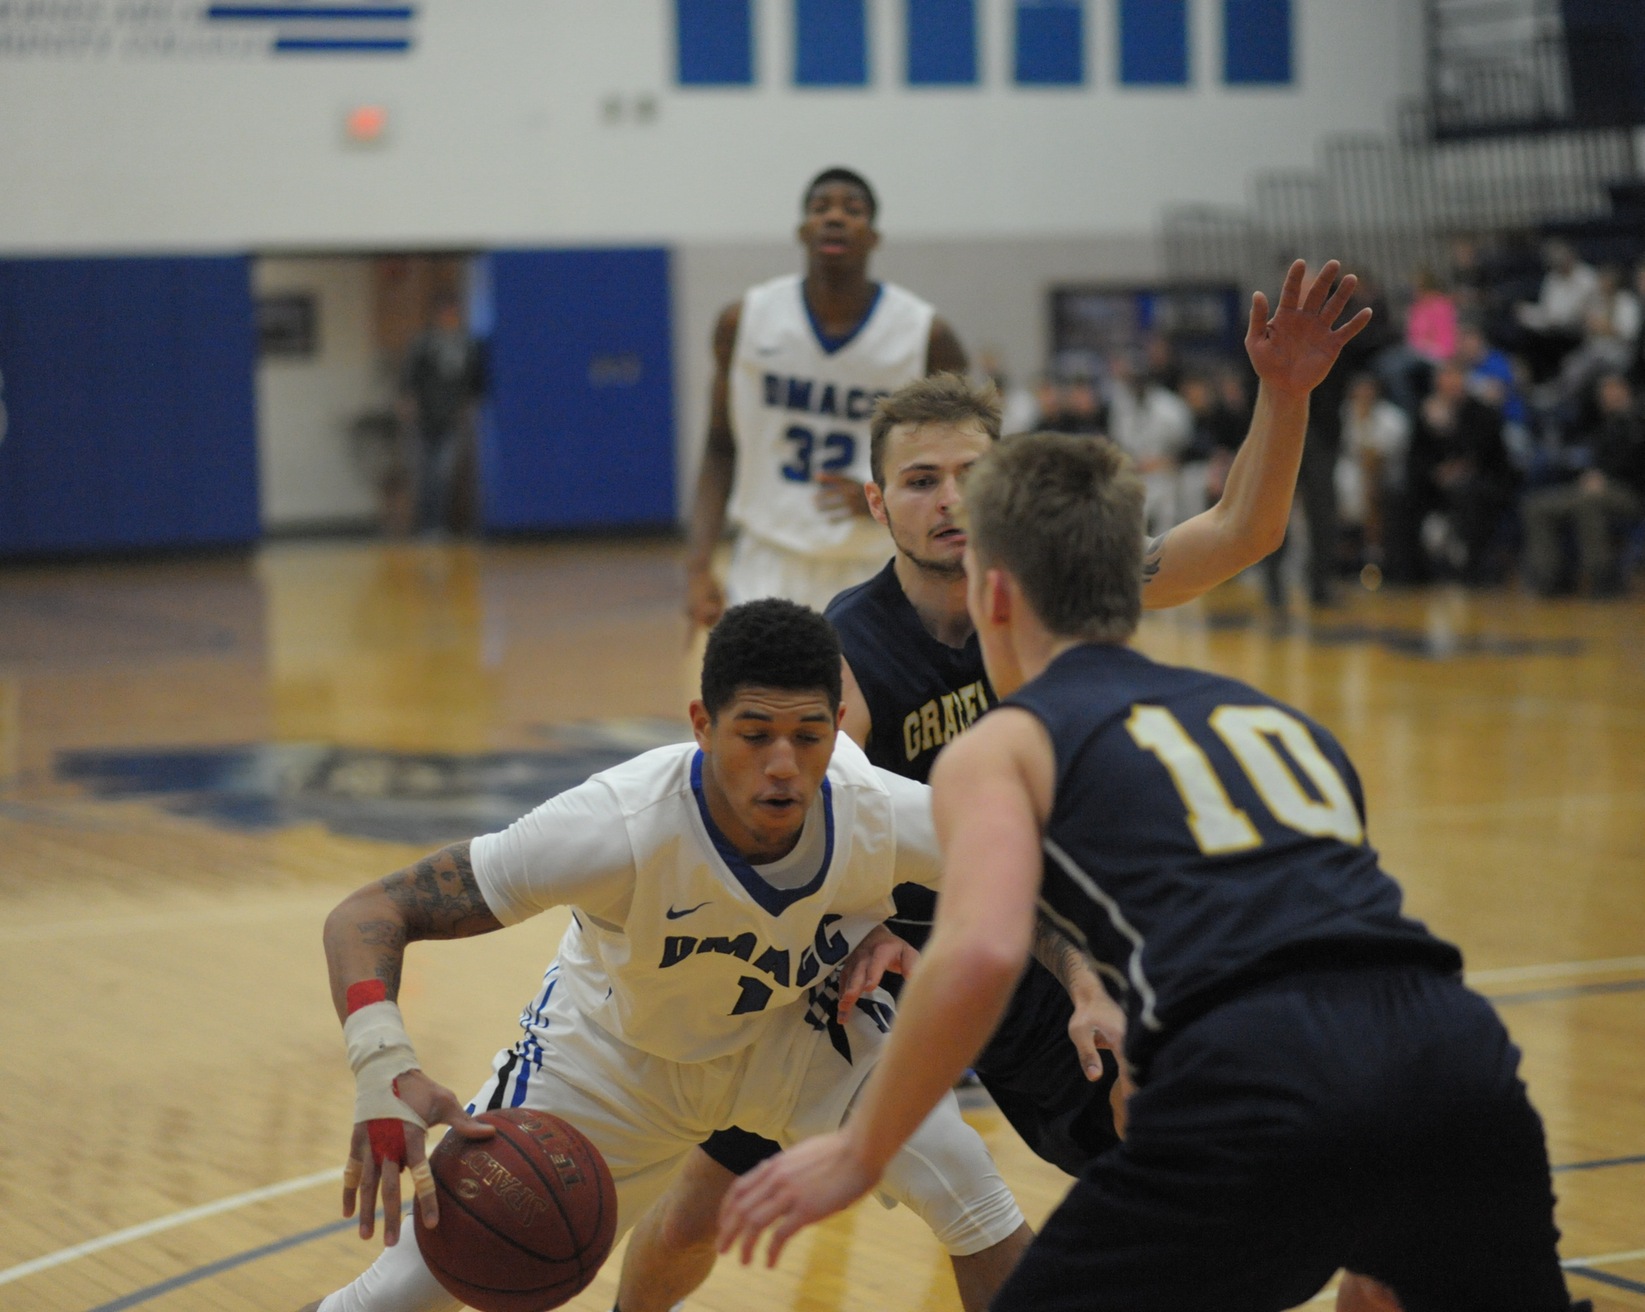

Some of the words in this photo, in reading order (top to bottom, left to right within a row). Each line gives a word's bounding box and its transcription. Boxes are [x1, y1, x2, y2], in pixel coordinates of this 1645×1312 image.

[763, 373, 889, 421] DMAC
[781, 424, 855, 482] 32
[1124, 703, 1364, 856] 10
